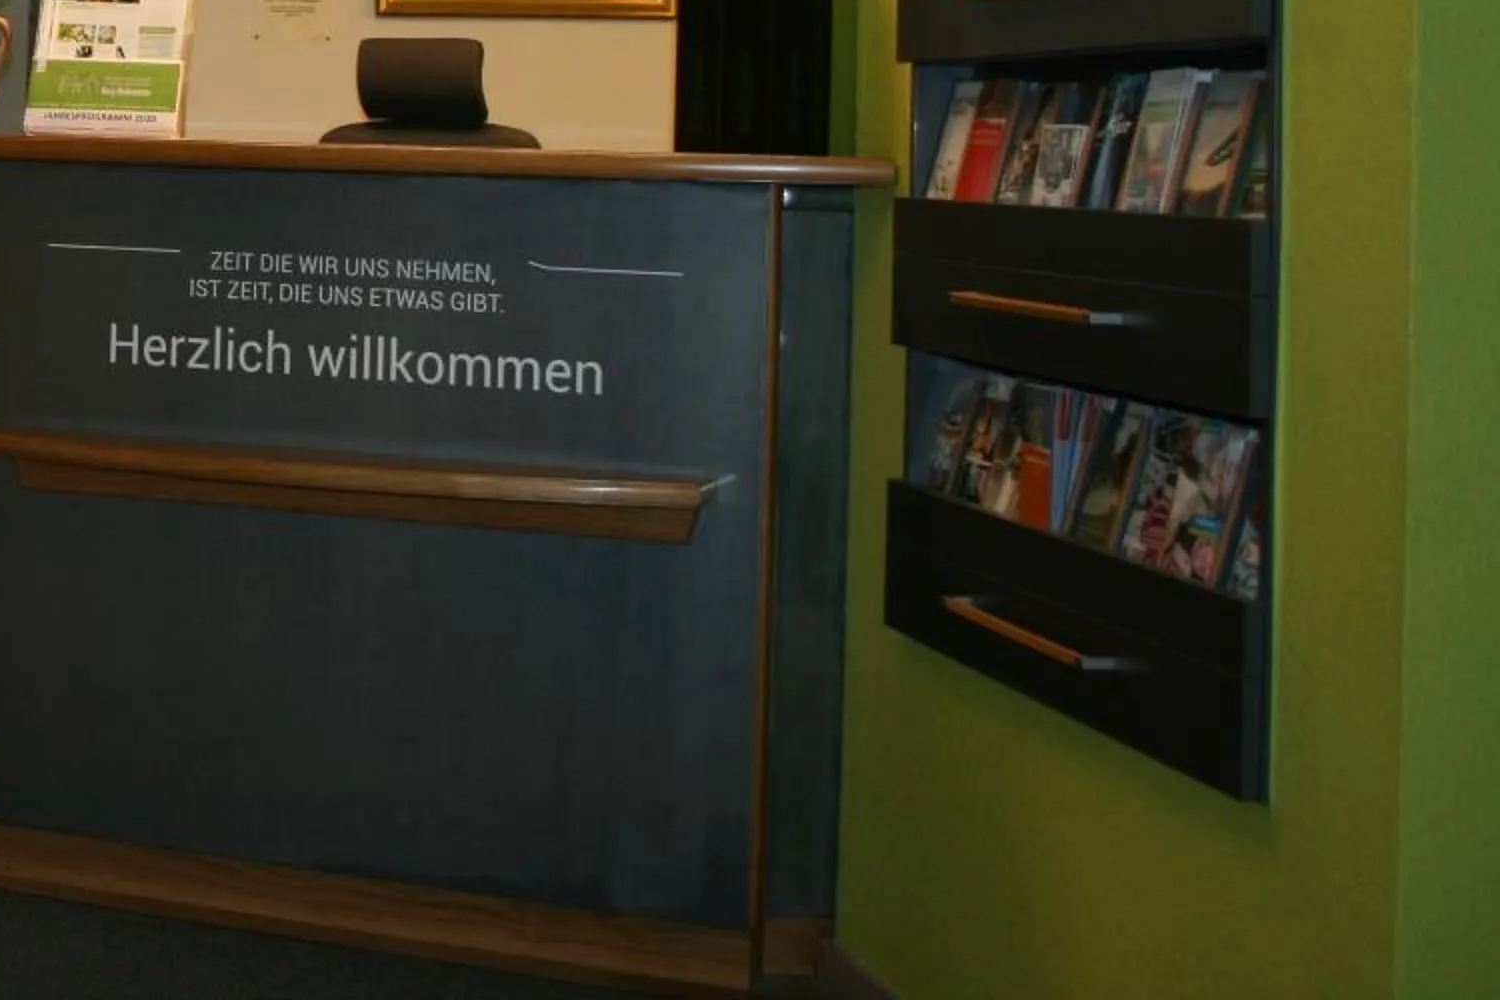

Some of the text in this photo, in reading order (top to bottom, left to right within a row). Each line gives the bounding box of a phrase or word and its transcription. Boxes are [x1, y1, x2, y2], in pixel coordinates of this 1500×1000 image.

[210, 250, 496, 286] ZEIT DIE WIR UNS NEHMEN,
[189, 278, 505, 314] IST ZEIT, DIE UNS ETWAS GIBT.
[109, 322, 604, 396] Herzlich willkommen
